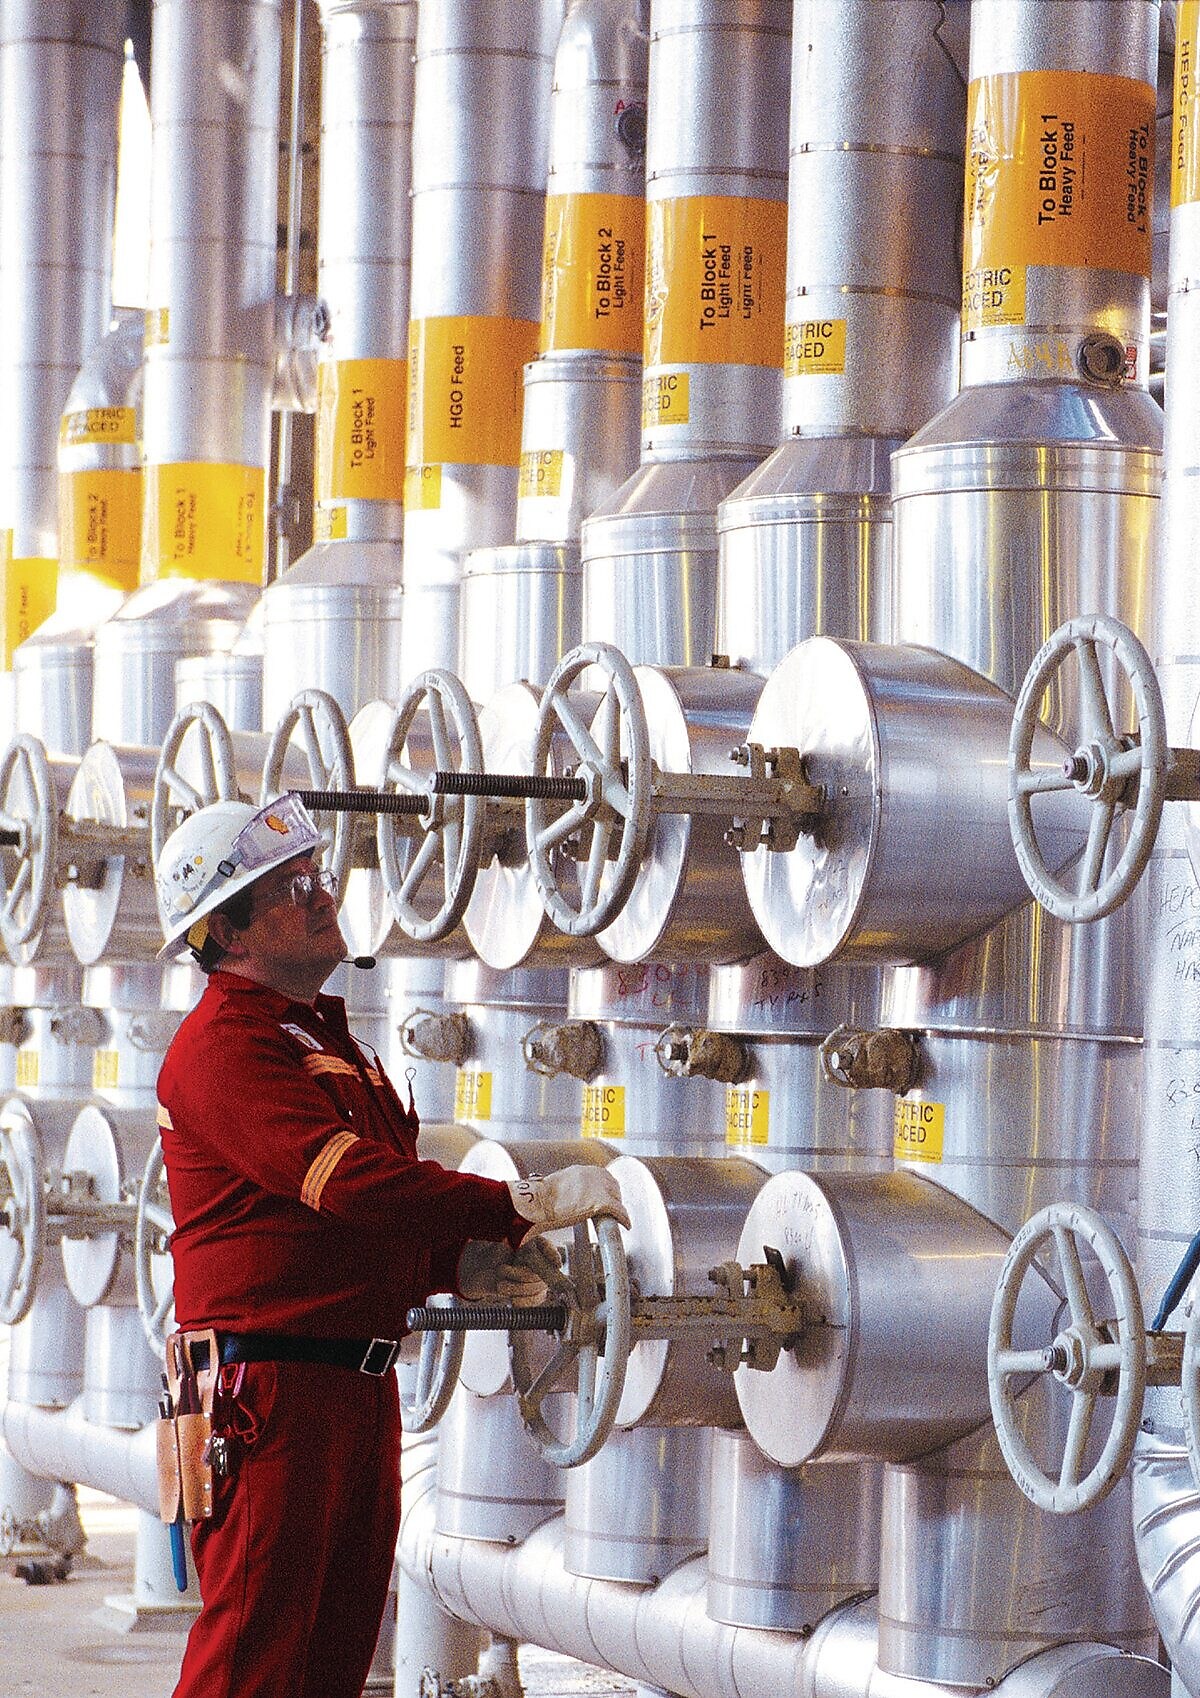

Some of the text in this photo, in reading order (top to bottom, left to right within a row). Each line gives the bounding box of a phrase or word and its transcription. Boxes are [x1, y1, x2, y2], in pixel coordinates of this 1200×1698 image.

[1178, 41, 1190, 170] HEPC Feed
[1038, 115, 1058, 226] To Block 1
[1059, 122, 1077, 216] Heavy Feed
[1127, 129, 1139, 223] Heavy Feed
[1137, 124, 1149, 233] To Block 1
[596, 228, 612, 319] To Block 2
[613, 240, 627, 309] Light Feed
[700, 234, 717, 331] To Block 1
[719, 244, 733, 319] Light Feed
[786, 321, 834, 343] ECTRIC
[351, 388, 364, 469] To Block 1
[366, 397, 378, 460] Light Feed
[450, 345, 466, 429] HGO Feed
